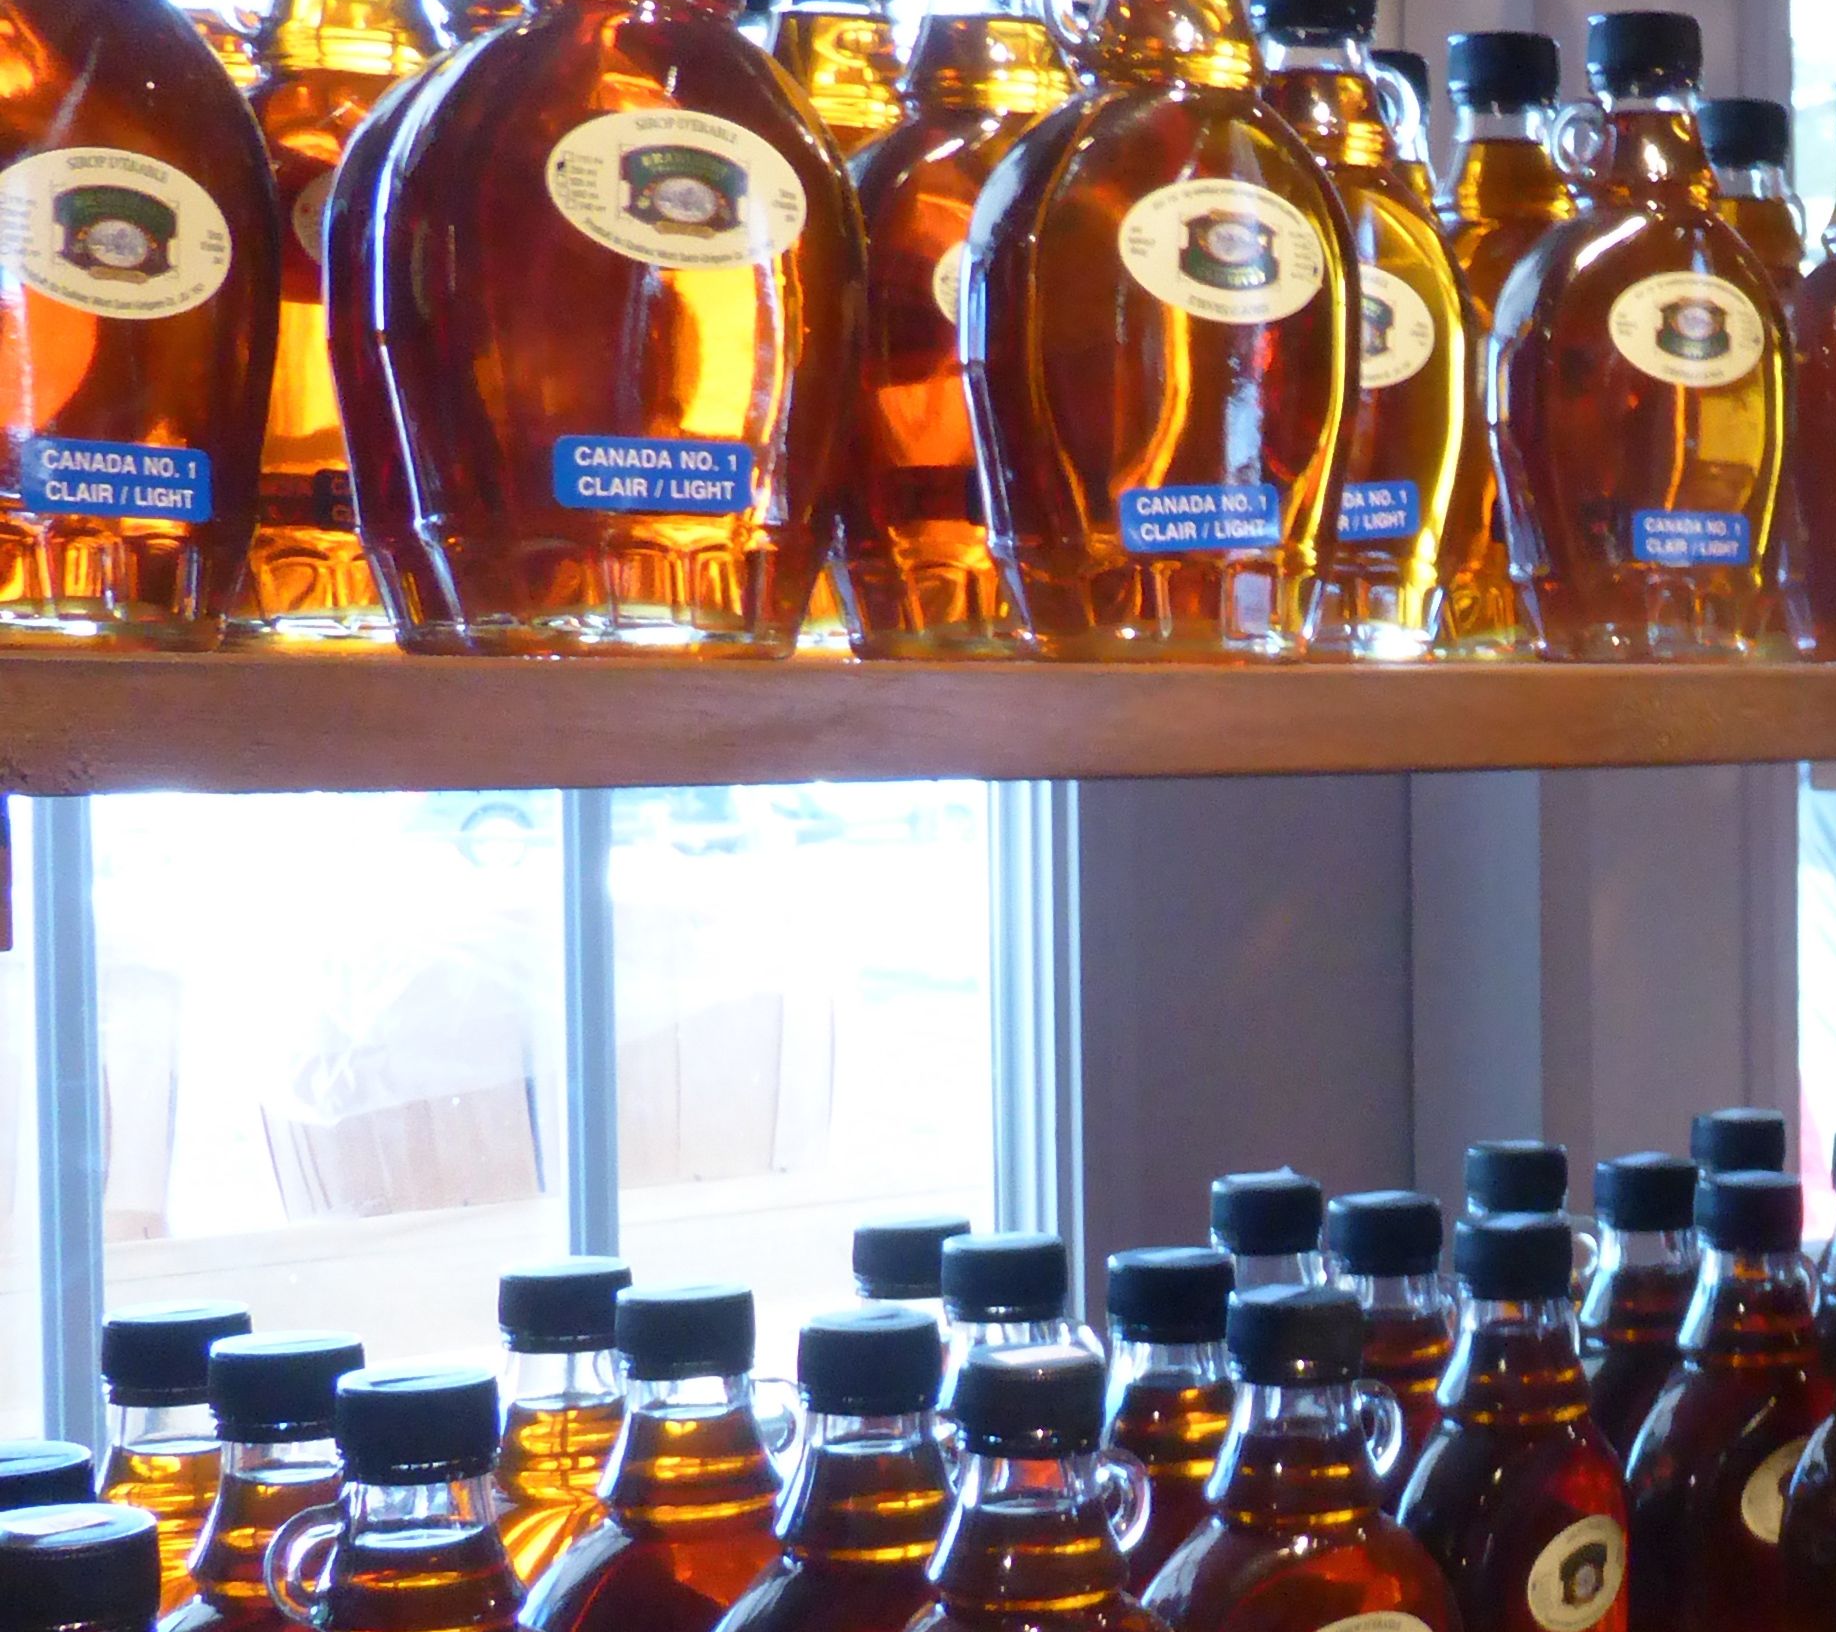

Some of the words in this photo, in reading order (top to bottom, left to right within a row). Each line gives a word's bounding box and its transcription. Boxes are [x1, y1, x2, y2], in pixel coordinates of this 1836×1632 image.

[42, 449, 137, 476] CANADA
[142, 456, 180, 478] NO.
[188, 460, 197, 480] 1
[574, 445, 673, 470] CANADA
[679, 450, 719, 472] NO.
[727, 454, 738, 472] 1
[45, 480, 114, 504] CLAIR
[119, 486, 129, 505] /
[133, 486, 194, 509] LIGHT
[578, 475, 648, 498] CLAIR
[653, 479, 664, 499] /
[670, 479, 736, 500] LIGHT
[1398, 489, 1408, 504] 1
[1136, 493, 1216, 515] CANADA
[1221, 493, 1253, 512] NO.
[1258, 495, 1267, 511] 1
[1140, 520, 1197, 542] CLAIR
[1201, 521, 1209, 538] /
[1214, 519, 1266, 538] LIGHT
[1364, 510, 1407, 529] LIGHT
[1643, 517, 1704, 534] CANADA
